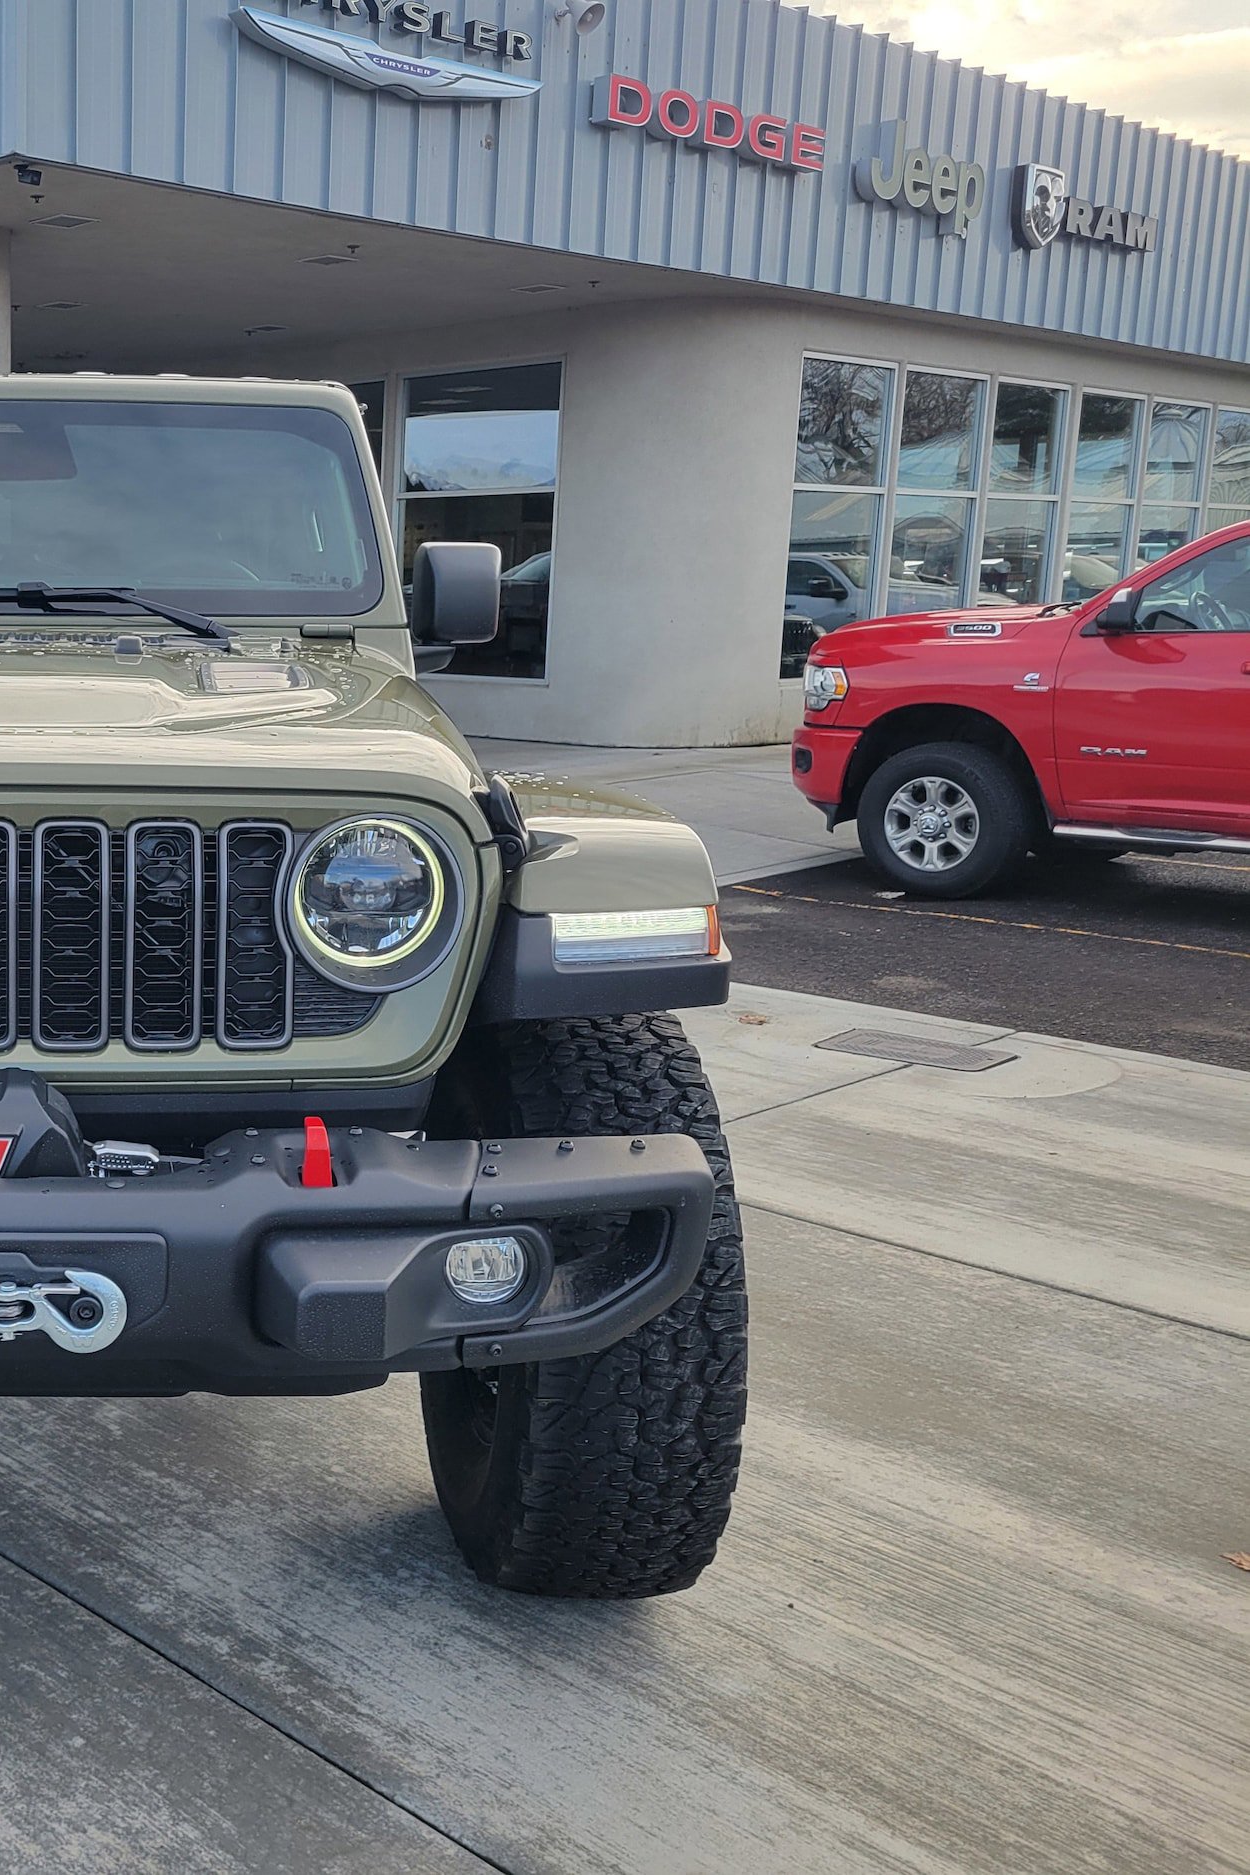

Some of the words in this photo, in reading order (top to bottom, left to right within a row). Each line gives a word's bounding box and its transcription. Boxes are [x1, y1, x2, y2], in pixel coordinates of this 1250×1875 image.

[310, 0, 532, 59] YSLER
[372, 57, 431, 76] CHRYSLER
[606, 73, 826, 172] DODGE
[869, 118, 985, 236] Jeep
[1065, 196, 1159, 252] RAM
[1079, 746, 1148, 757] RAM
